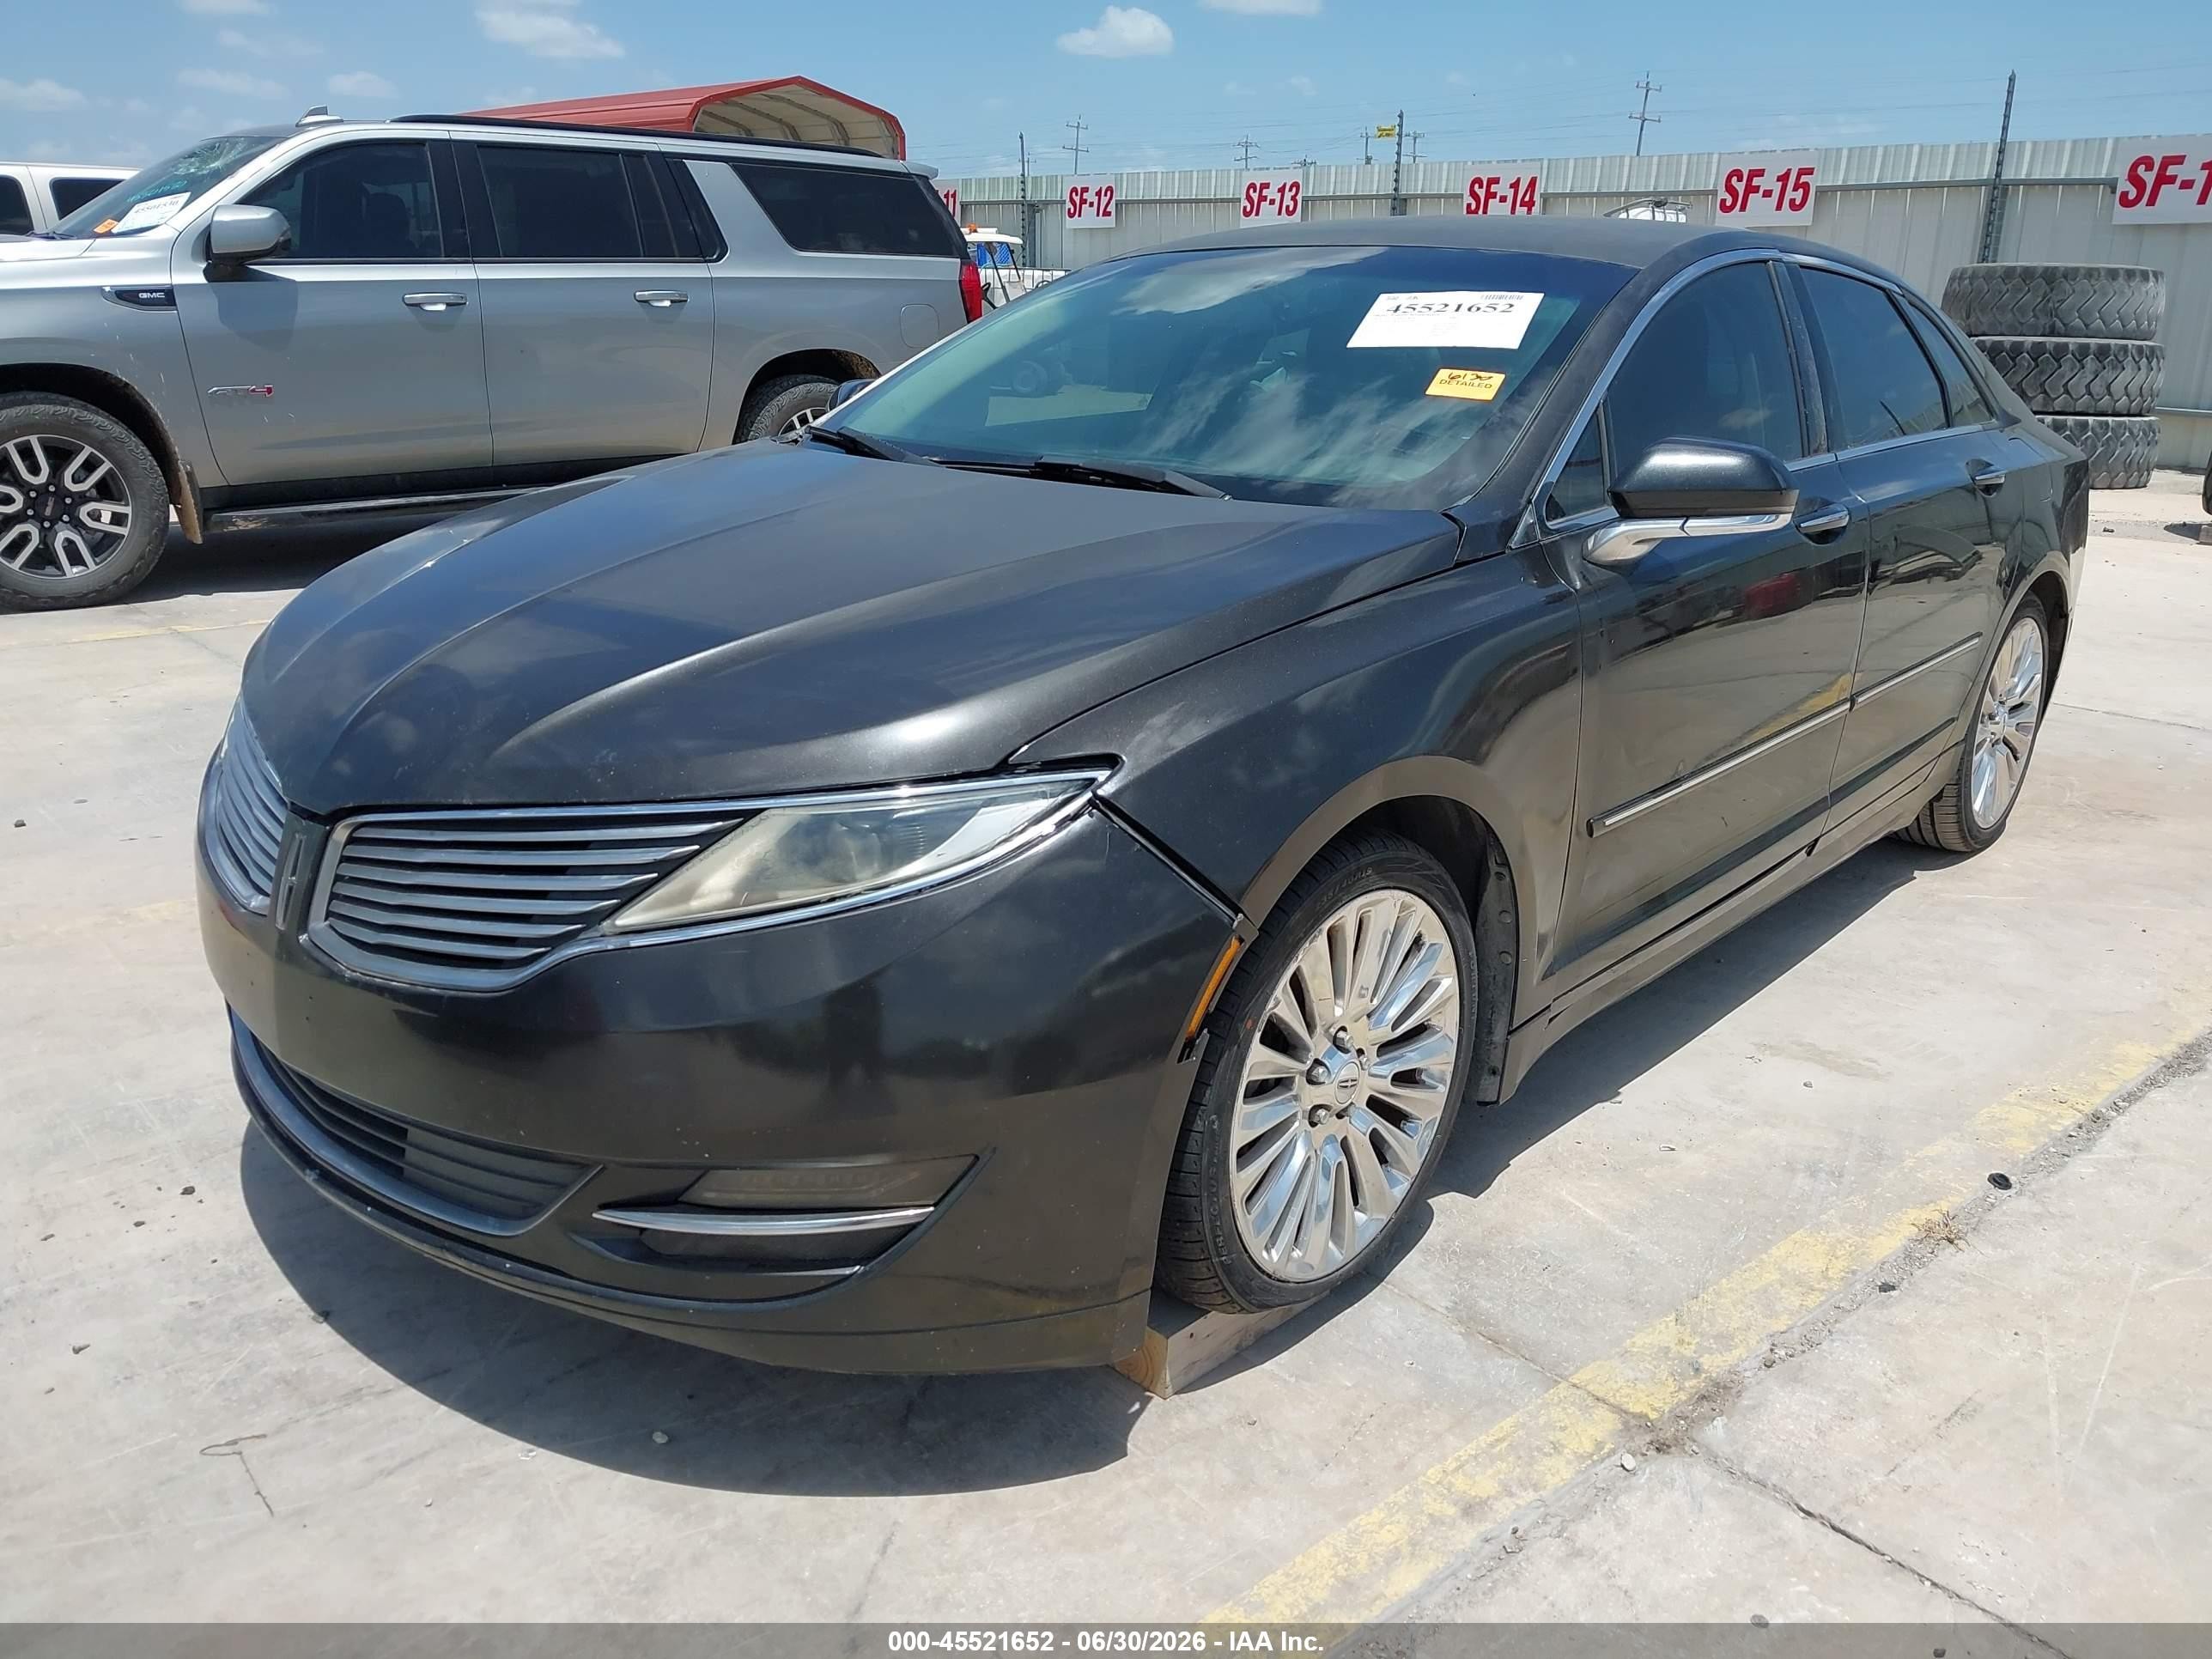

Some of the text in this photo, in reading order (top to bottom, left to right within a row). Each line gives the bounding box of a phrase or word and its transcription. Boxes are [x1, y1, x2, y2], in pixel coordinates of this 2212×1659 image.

[1066, 185, 1115, 218] SF-12
[1242, 181, 1301, 217] SF-13
[1466, 176, 1538, 215] SF-14
[1719, 167, 1814, 214] SF-15
[1387, 303, 1515, 313] 45521652
[1438, 379, 1493, 389] DETAILED
